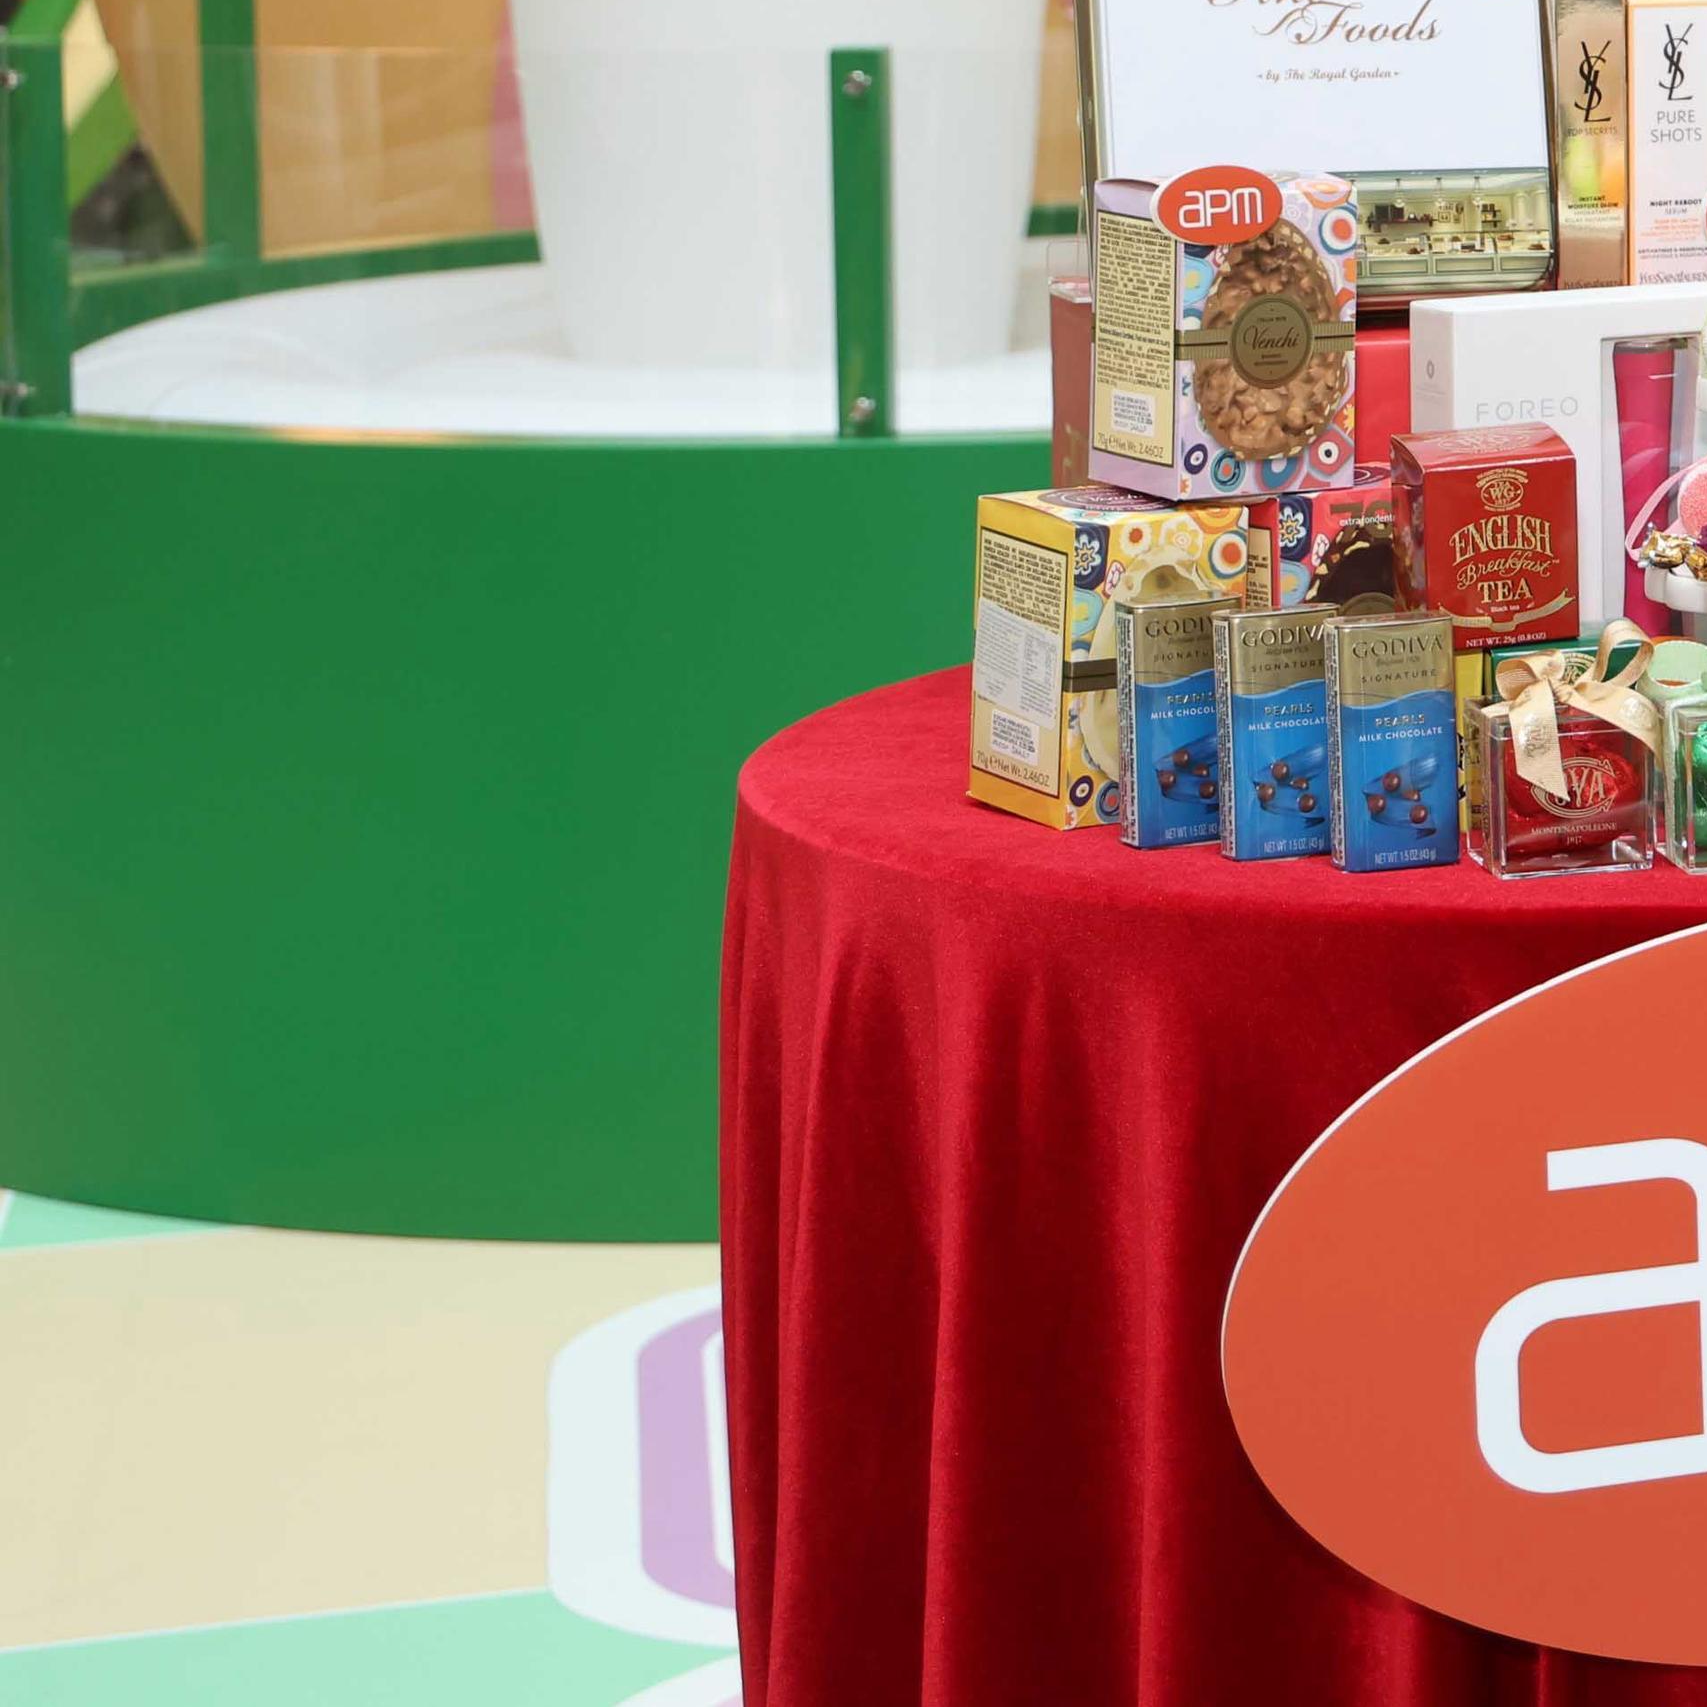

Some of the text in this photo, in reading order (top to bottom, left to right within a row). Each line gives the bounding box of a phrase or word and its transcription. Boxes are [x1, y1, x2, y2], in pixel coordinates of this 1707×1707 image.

[1266, 66, 1392, 83] by The Royal Garden
[1657, 110, 1696, 125] PURE
[1650, 127, 1703, 143] SHOTS
[1178, 186, 1264, 229] apm
[1243, 325, 1300, 350] Venchi
[1476, 396, 1579, 423] FOREO
[1339, 513, 1394, 527] extrafondent
[1449, 514, 1553, 566] ENGLISH
[1457, 551, 1551, 590] Breakfast
[1477, 578, 1534, 604] TEA
[1352, 633, 1443, 659] GODIVA
[1466, 638, 1484, 648] NET
[1361, 668, 1438, 683] SIGNATURE
[1151, 707, 1216, 720] MILK CHOCOL
[1264, 703, 1314, 716] PEARLS
[1248, 718, 1327, 731] MILK CHOCOLAT
[1375, 714, 1425, 727] PEARLS
[1359, 726, 1443, 742] MILK CHOCOLATE
